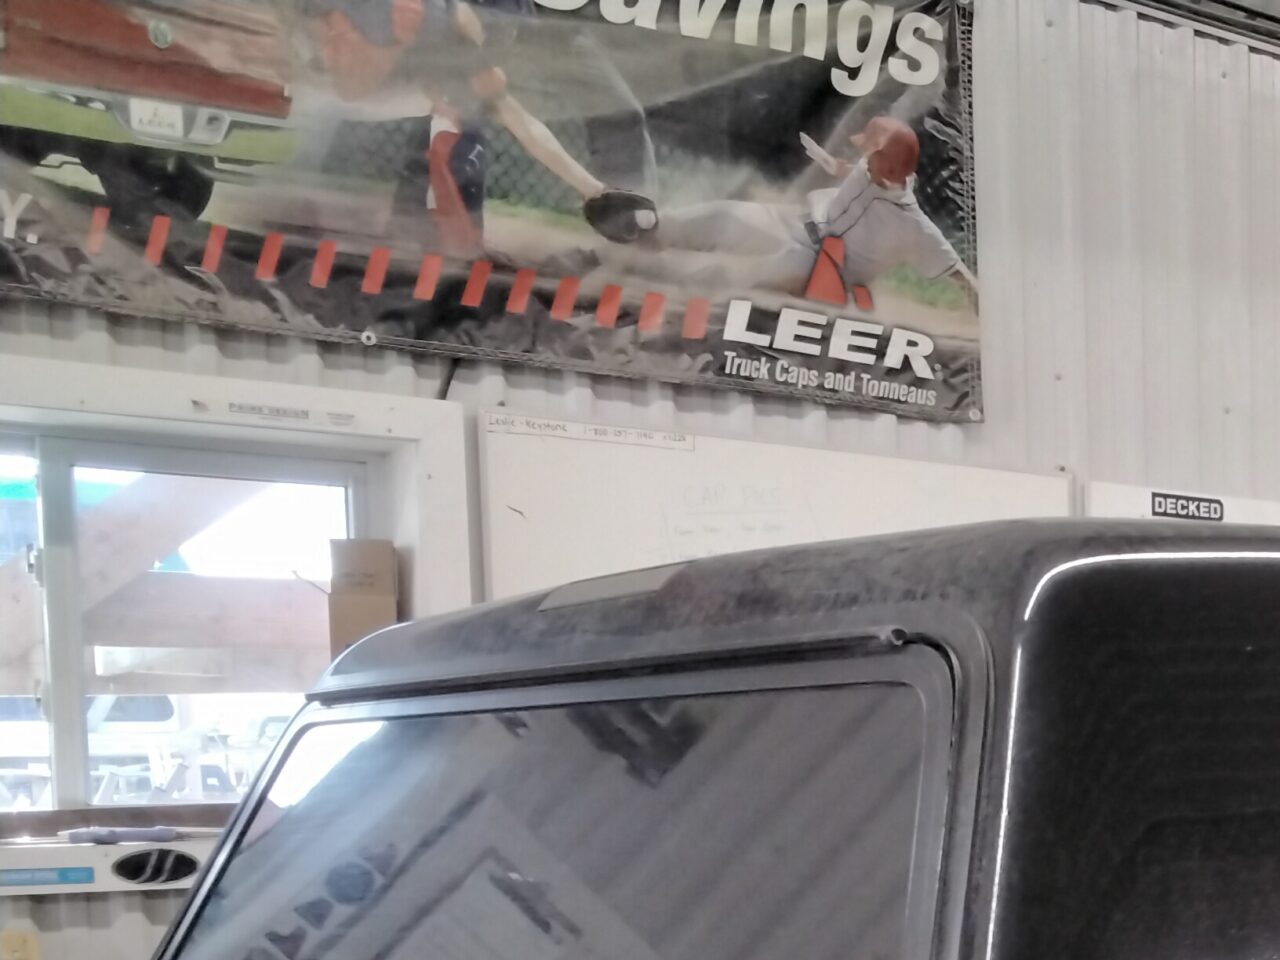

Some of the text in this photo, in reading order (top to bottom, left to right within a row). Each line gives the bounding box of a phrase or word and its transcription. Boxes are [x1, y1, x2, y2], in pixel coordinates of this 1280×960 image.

[722, 299, 935, 380] LEER
[724, 351, 937, 406] Truck Caps and Tonneaus
[1153, 496, 1221, 518] DECKED
